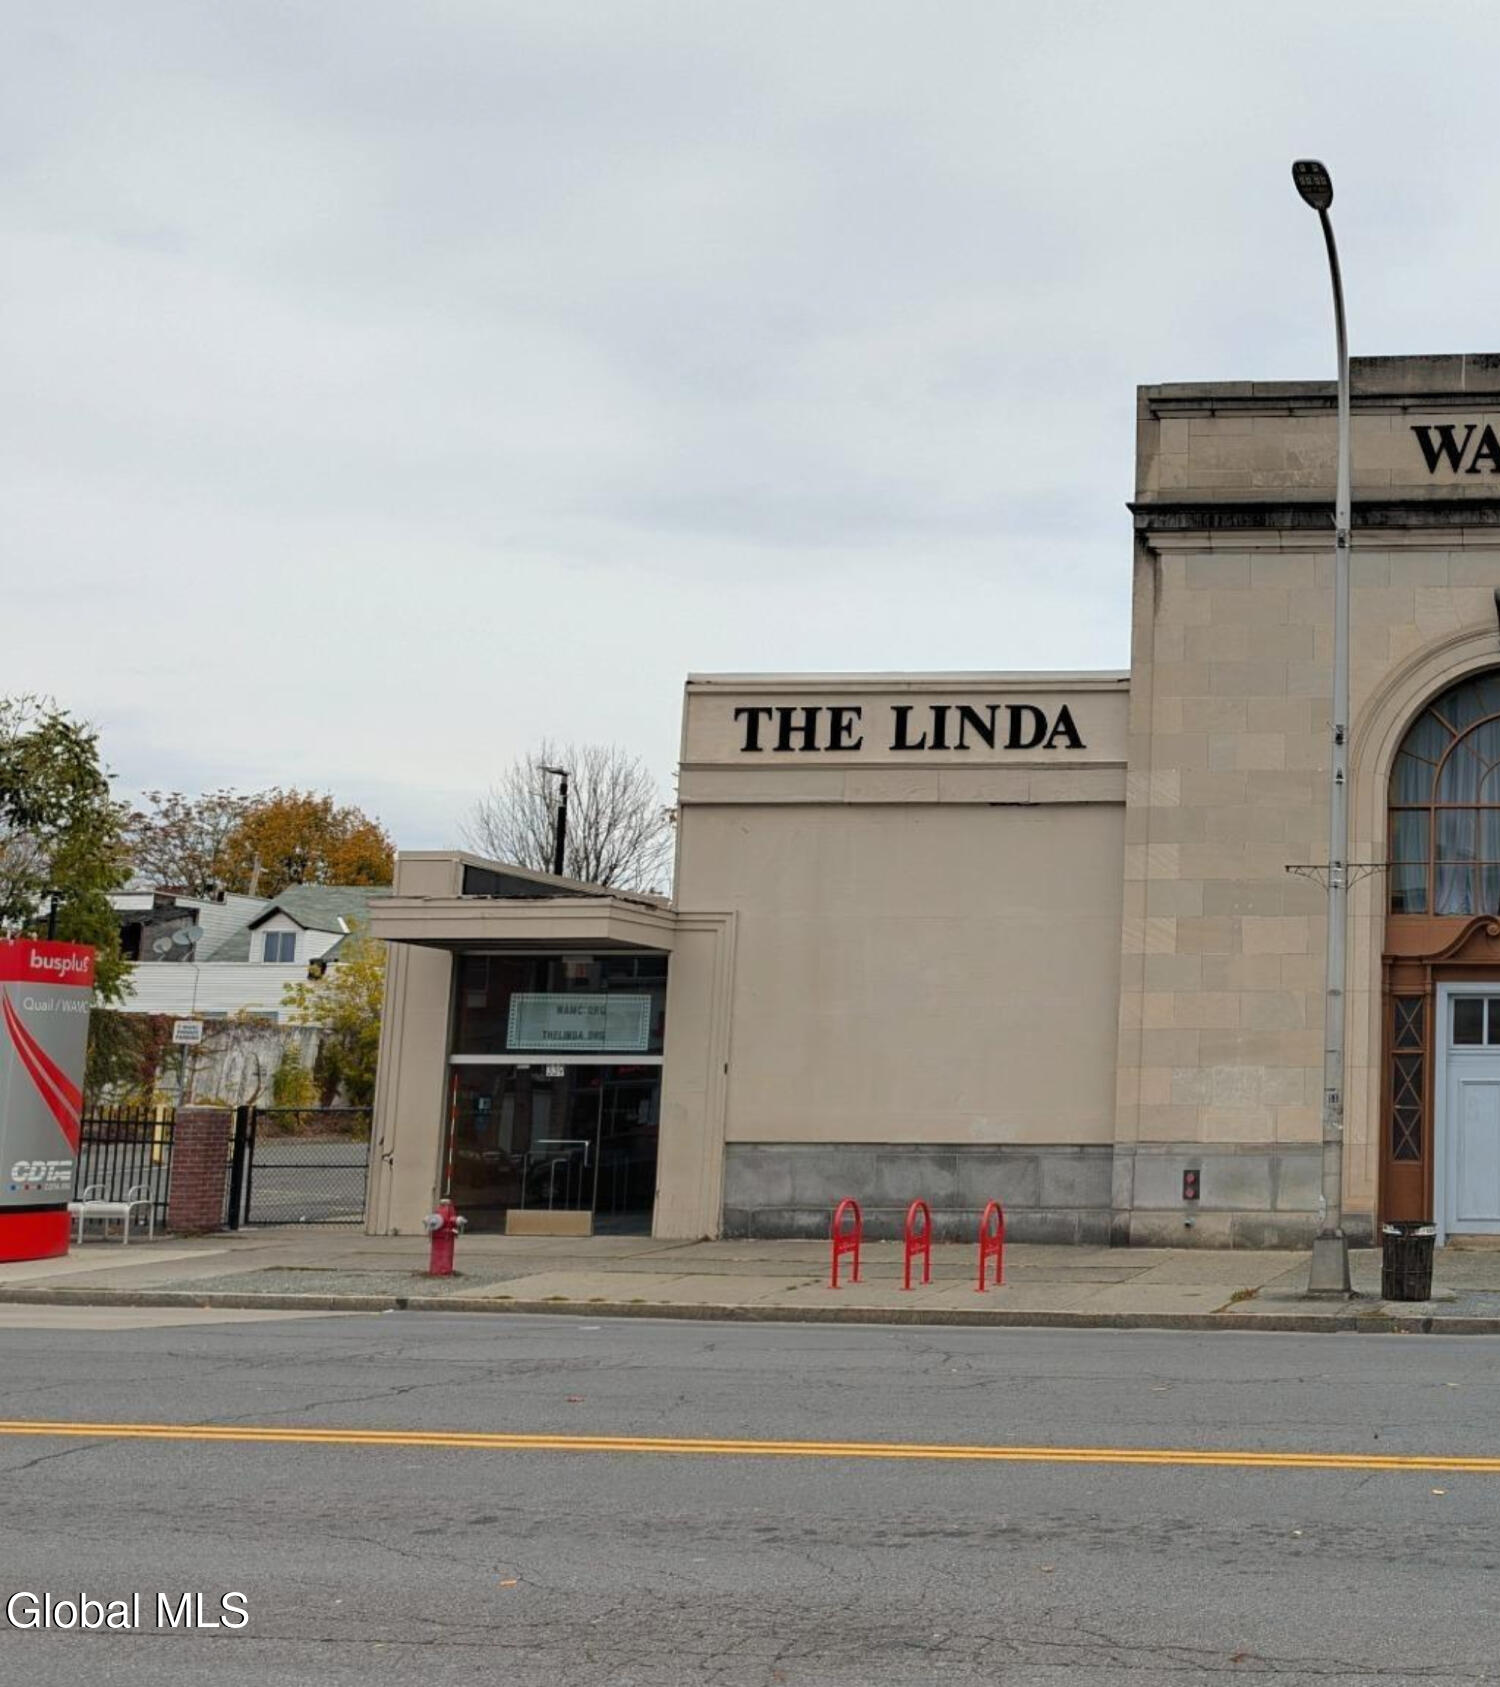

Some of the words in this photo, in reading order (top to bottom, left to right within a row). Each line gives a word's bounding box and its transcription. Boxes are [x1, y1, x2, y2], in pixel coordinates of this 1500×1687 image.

[733, 706, 864, 752] THE
[889, 704, 1087, 750] LINDA
[30, 948, 90, 978] busplus
